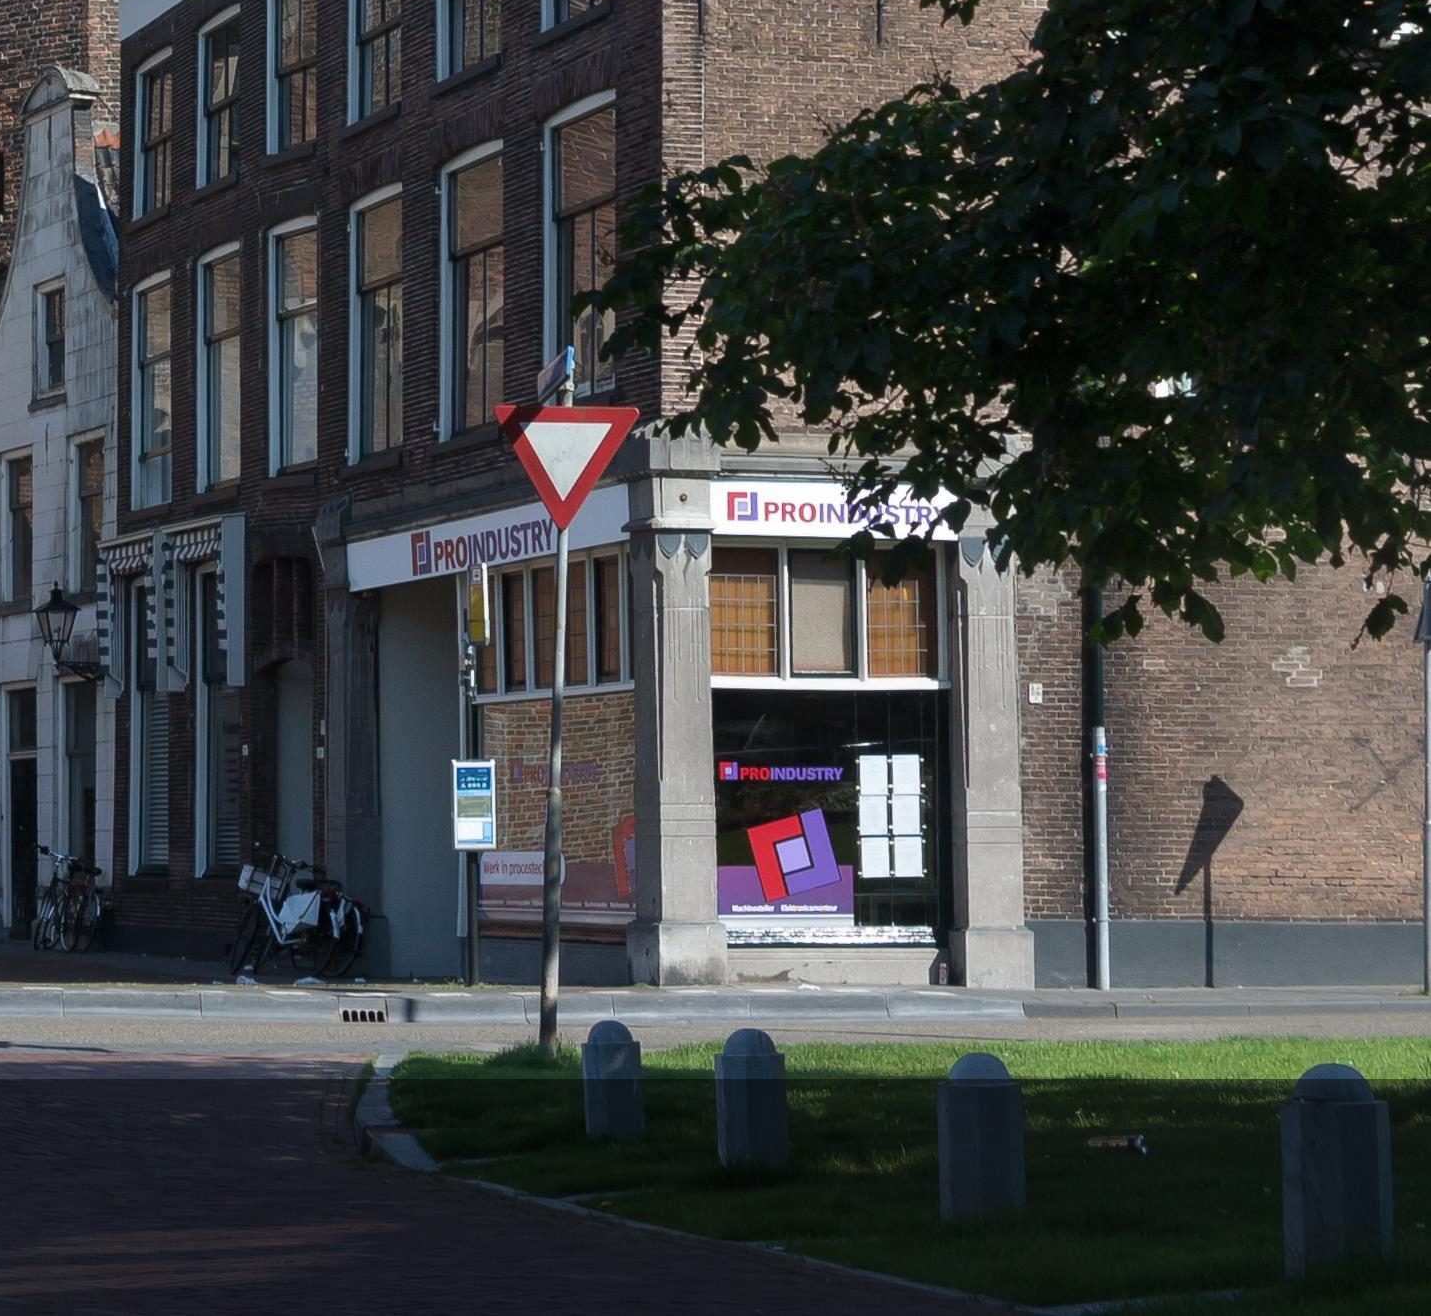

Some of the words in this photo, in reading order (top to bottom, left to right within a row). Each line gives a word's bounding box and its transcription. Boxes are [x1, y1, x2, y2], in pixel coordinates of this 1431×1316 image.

[433, 518, 554, 572] PROINDUSTRY
[740, 767, 844, 781] PROINDUSTRY
[509, 862, 545, 877] procestec
